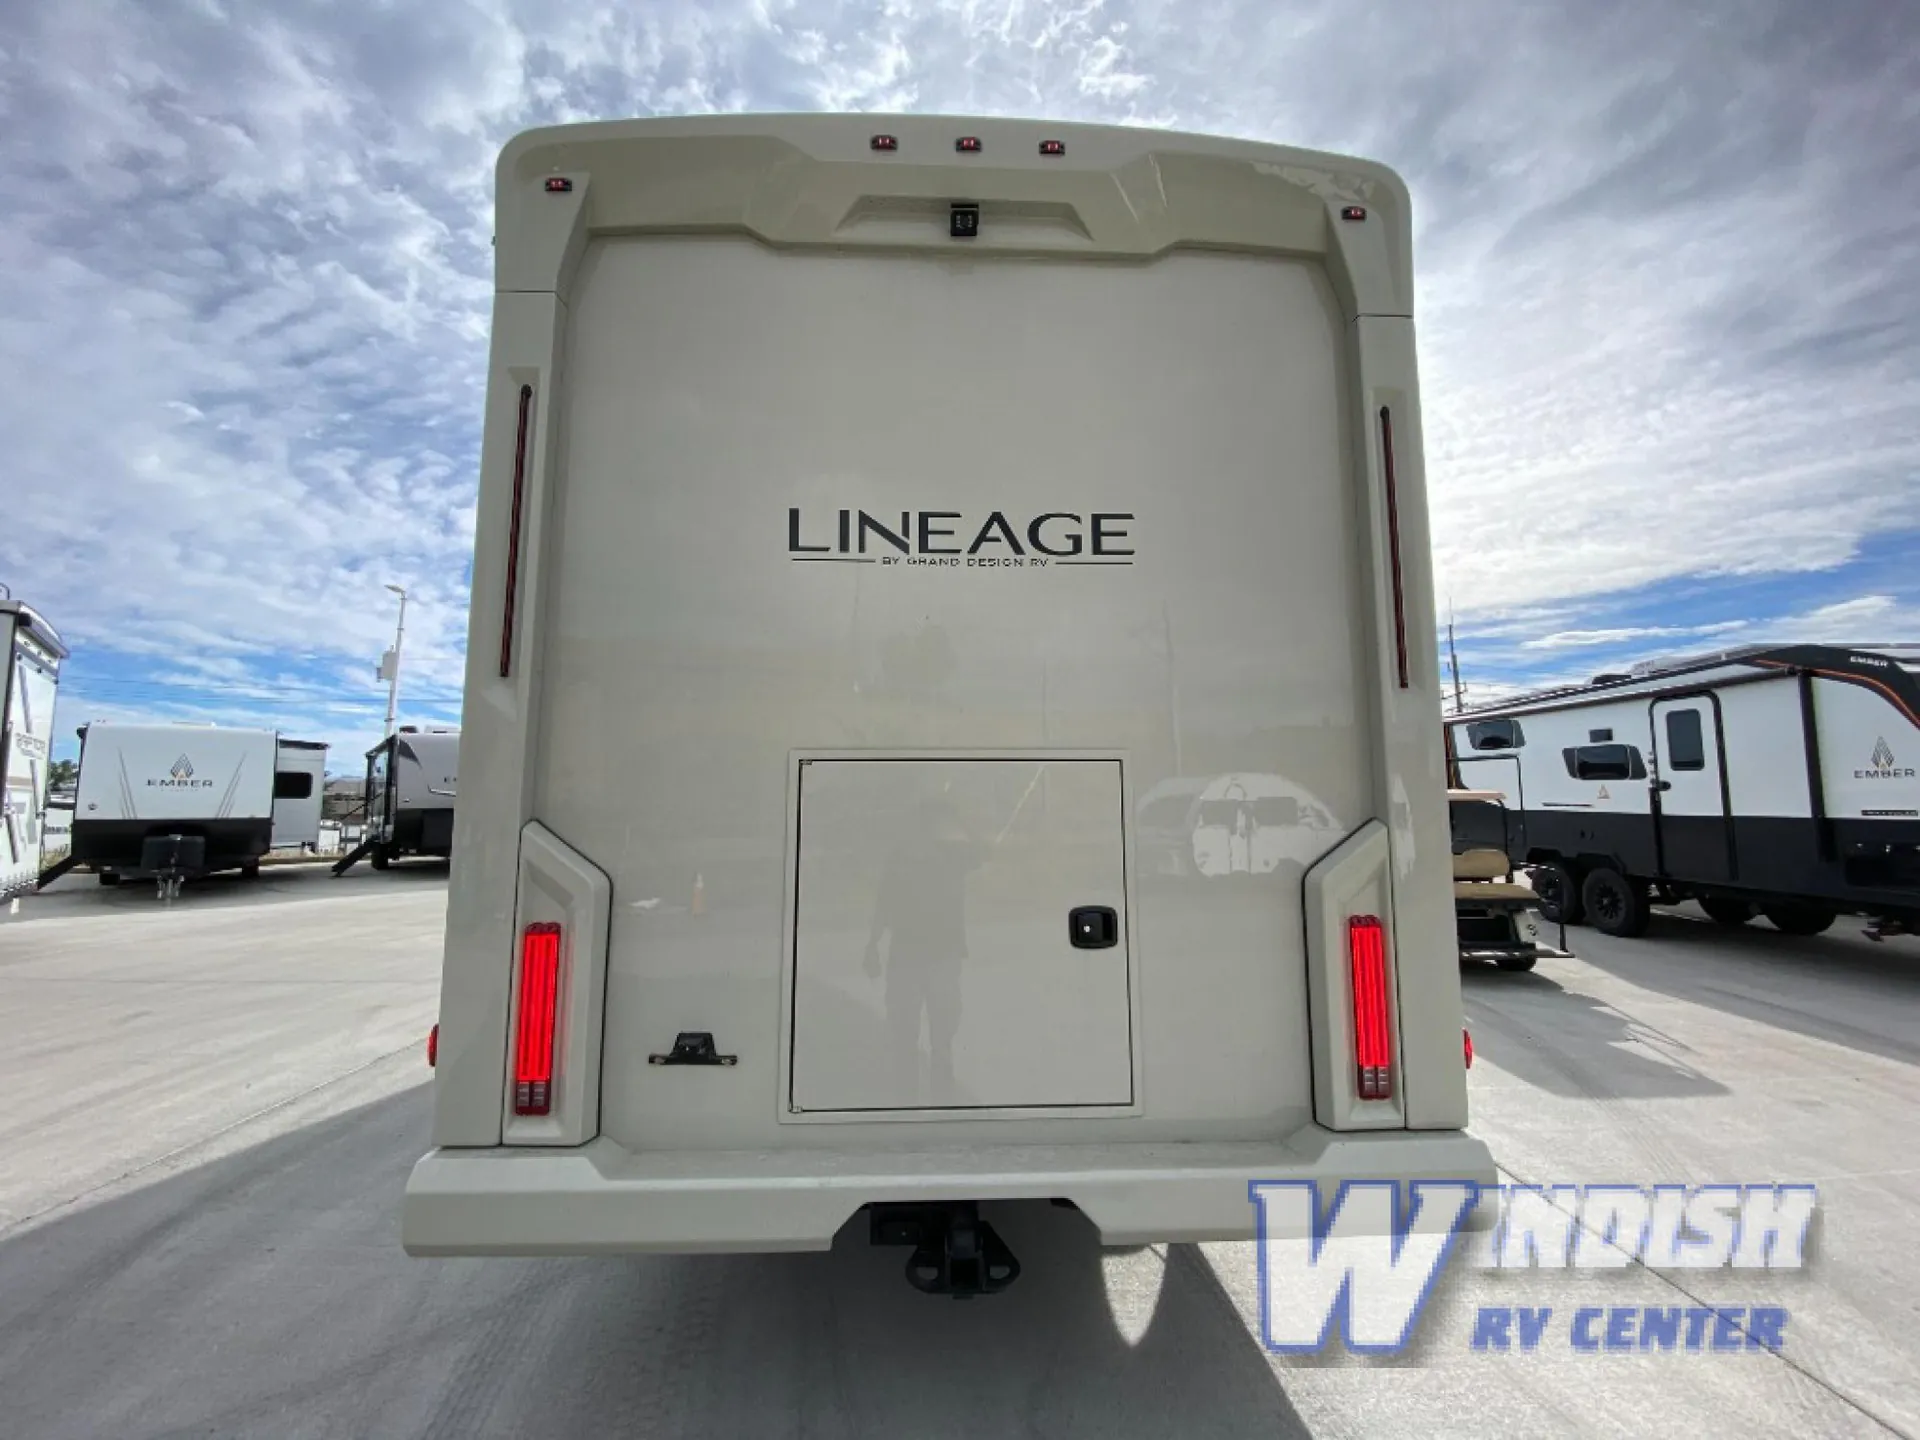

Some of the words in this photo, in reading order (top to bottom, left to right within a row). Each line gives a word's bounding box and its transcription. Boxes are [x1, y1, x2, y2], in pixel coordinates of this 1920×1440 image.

[788, 508, 1136, 556] LINEAGE
[882, 556, 900, 566] BY
[907, 558, 960, 567] GRAND
[967, 558, 1024, 567] DESIGN
[1030, 558, 1049, 567] RV
[1850, 655, 1888, 667] EMBER
[1853, 768, 1915, 778] EMBER
[146, 779, 213, 787] EMBER
